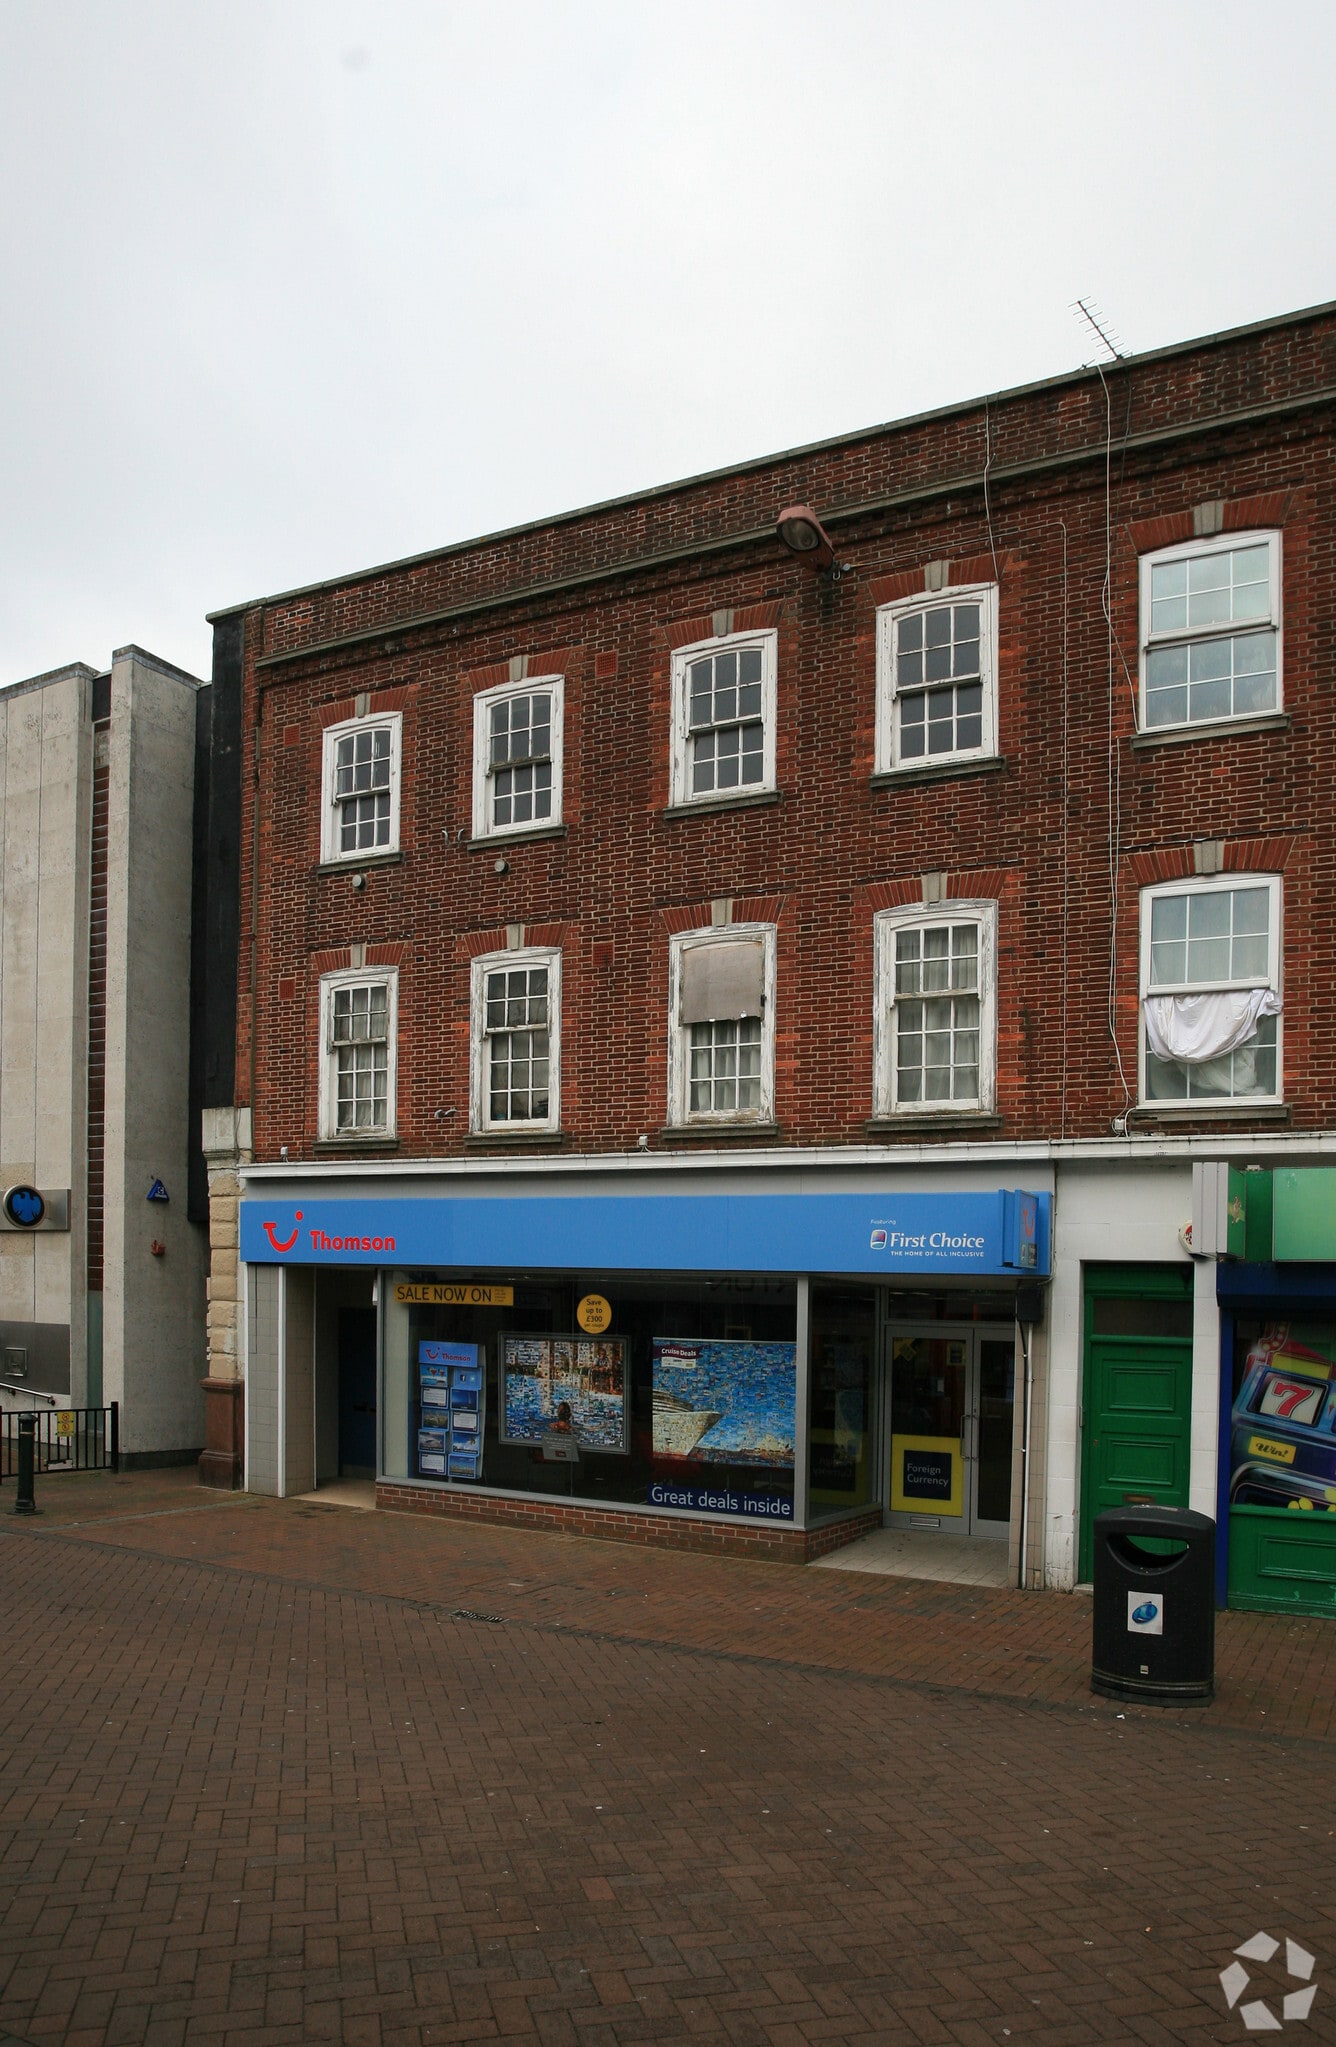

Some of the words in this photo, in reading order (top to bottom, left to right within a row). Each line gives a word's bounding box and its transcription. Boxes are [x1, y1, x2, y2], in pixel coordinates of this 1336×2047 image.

[310, 1230, 396, 1252] Thomson
[890, 1232, 926, 1248] First
[929, 1232, 985, 1248] Choice
[397, 1286, 430, 1300] SALE
[433, 1287, 467, 1302] NOW
[471, 1288, 492, 1303] ON
[442, 1352, 471, 1362] Thomson
[680, 1349, 697, 1357] Deals
[1272, 1380, 1314, 1418] 7
[1255, 1442, 1289, 1458] Win!
[907, 1463, 941, 1476] Foreign
[907, 1473, 949, 1488] Currency
[651, 1486, 694, 1506] Great
[698, 1491, 738, 1510] deals
[743, 1495, 791, 1515] inside
